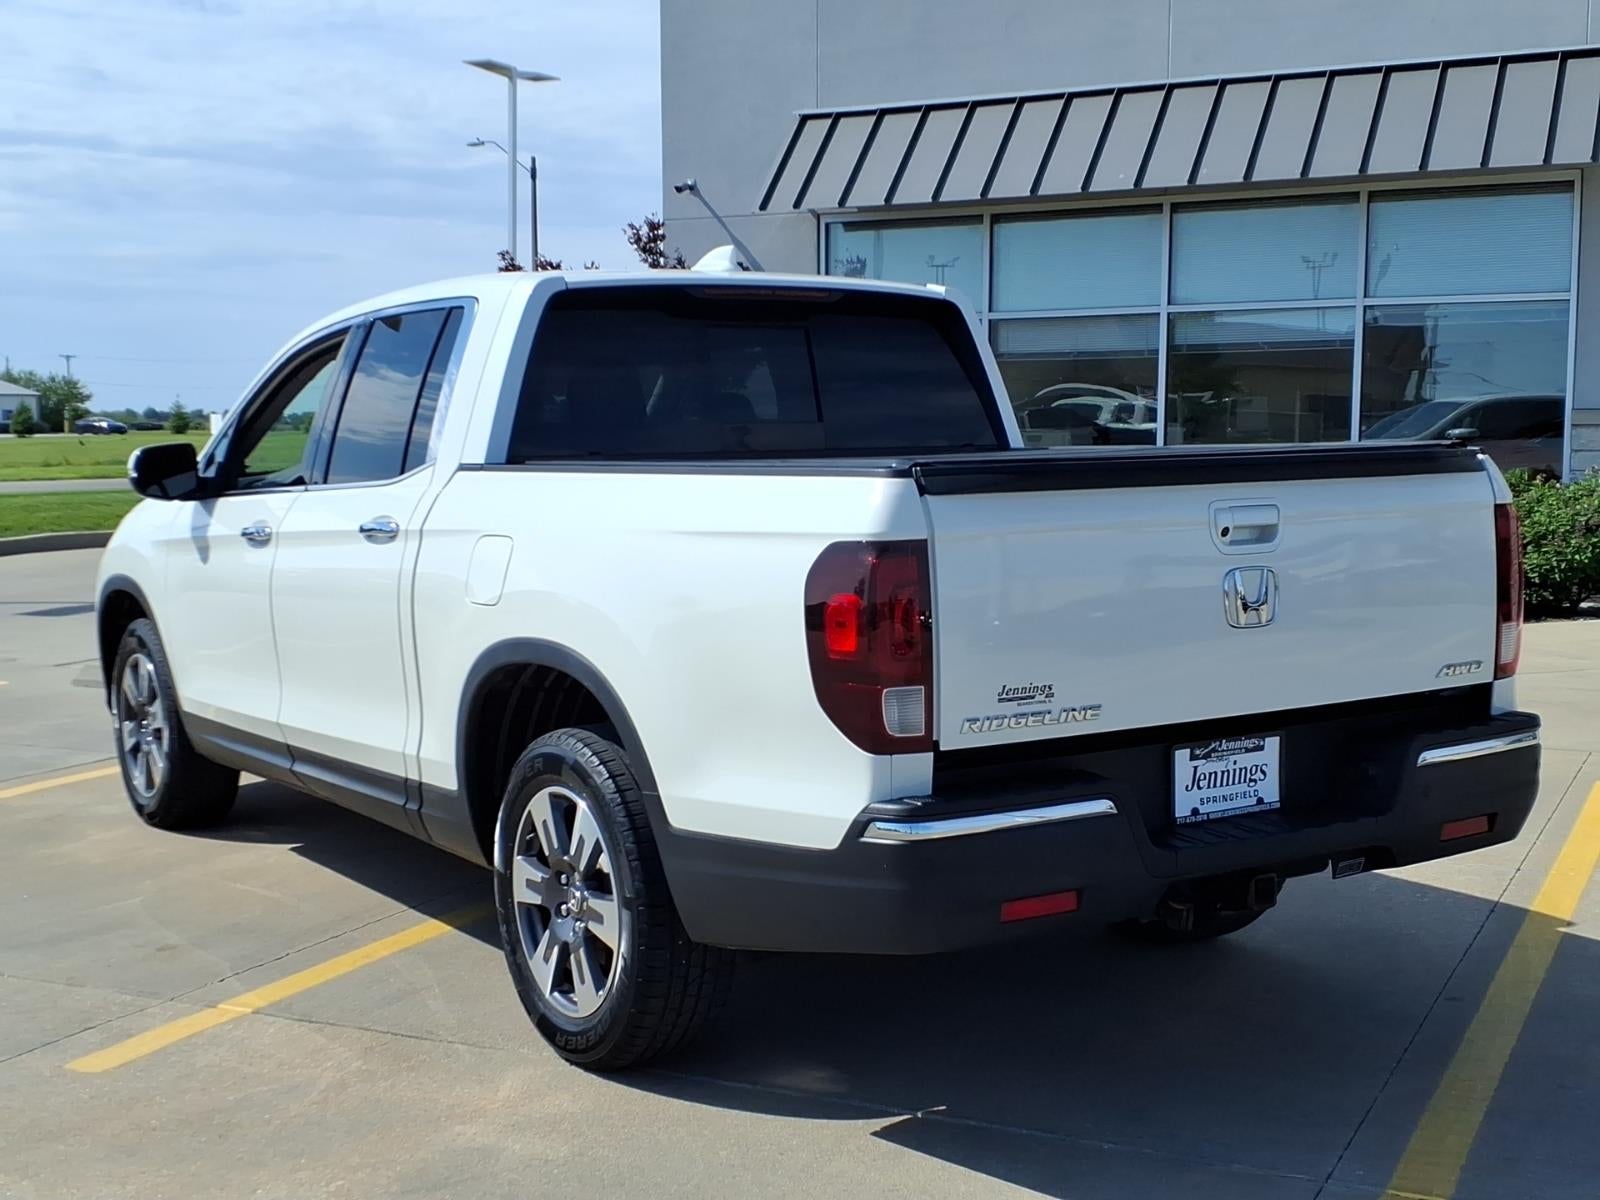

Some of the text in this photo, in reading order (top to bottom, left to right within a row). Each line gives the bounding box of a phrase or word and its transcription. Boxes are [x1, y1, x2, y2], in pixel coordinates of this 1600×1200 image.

[1435, 660, 1483, 678] AWD
[997, 682, 1054, 697] Jennings
[960, 704, 1102, 734] RIDGELINE
[1218, 736, 1259, 751] Jennings
[1185, 760, 1268, 792] Jennings
[1199, 789, 1260, 806] SPRINGFIELD
